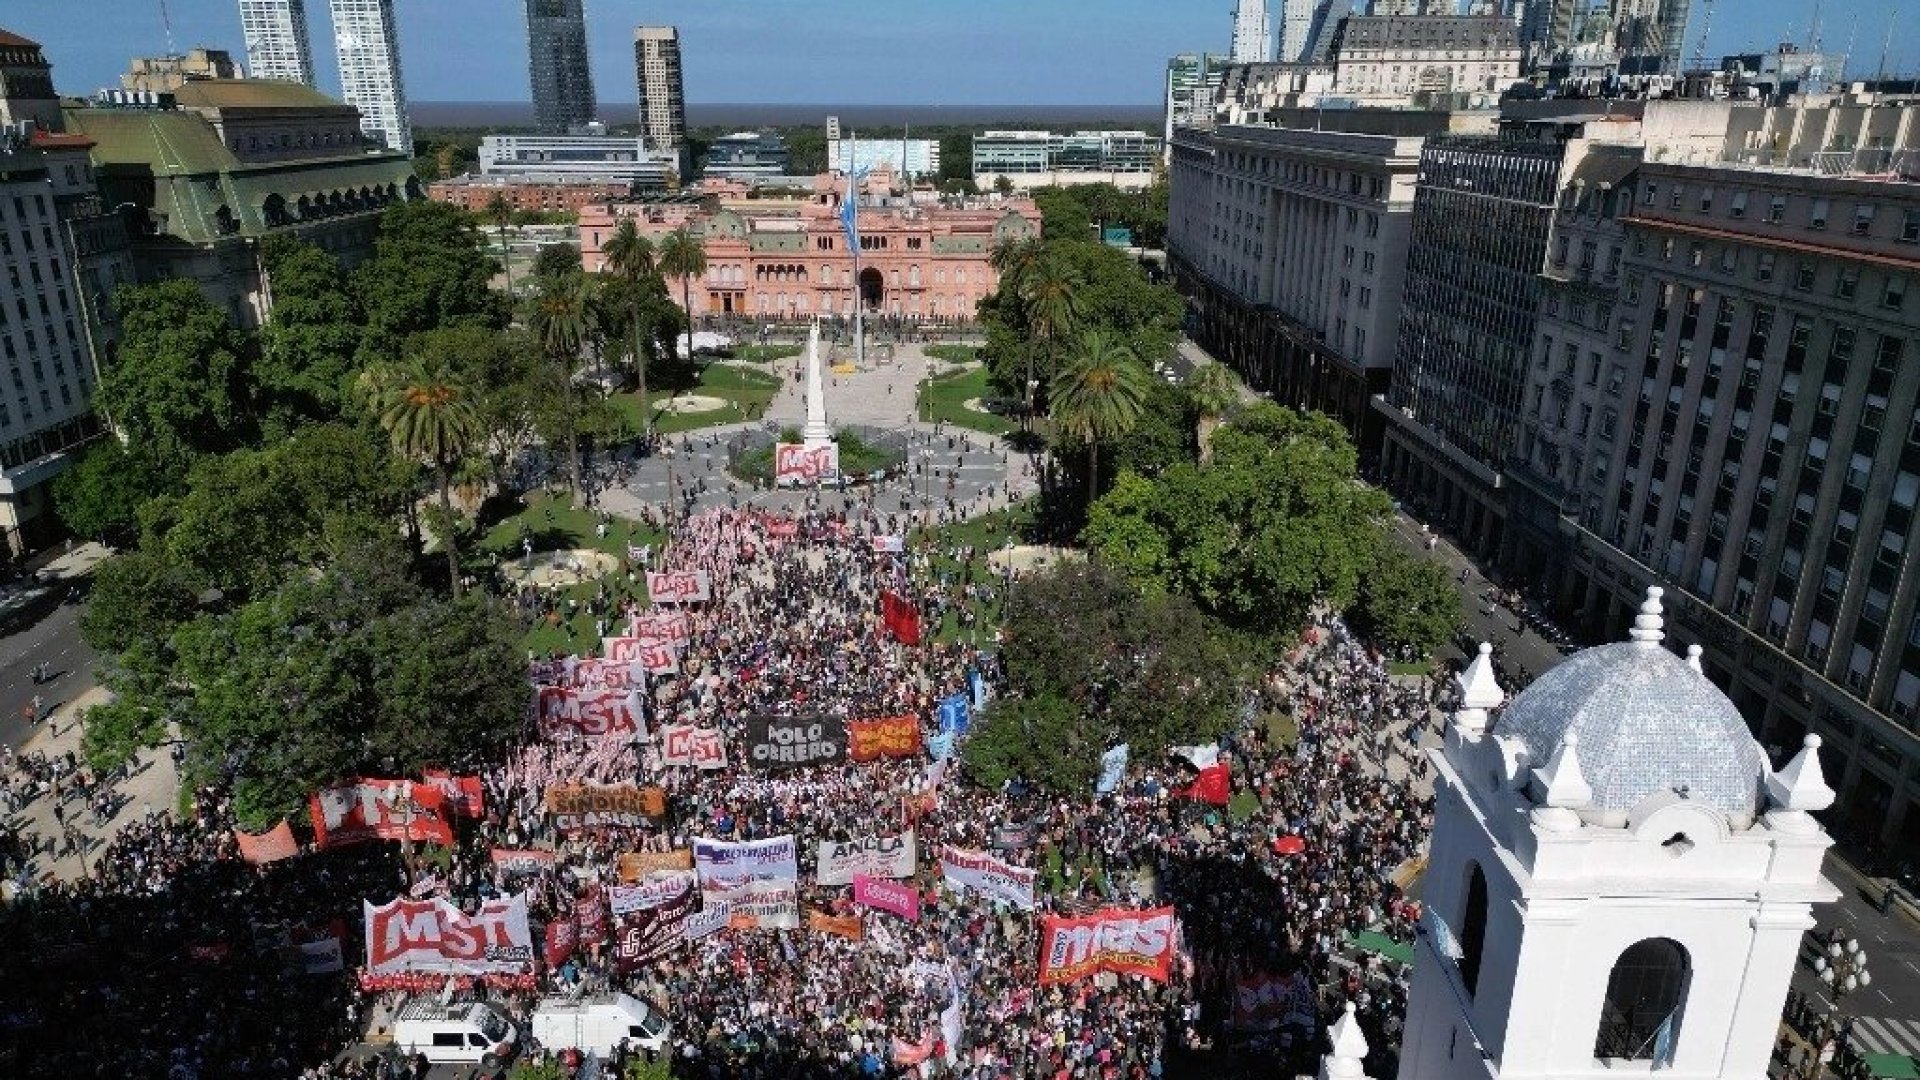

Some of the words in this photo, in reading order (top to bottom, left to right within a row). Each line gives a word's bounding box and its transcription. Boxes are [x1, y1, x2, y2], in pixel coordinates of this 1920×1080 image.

[777, 445, 832, 478] MST
[654, 573, 701, 597] MST
[637, 618, 685, 641] MST
[611, 639, 672, 668] MST
[539, 687, 638, 736] MST
[667, 728, 723, 762] MST
[768, 723, 822, 745] POLO
[753, 740, 838, 762] OBRERO
[831, 837, 905, 859] ANCLA
[372, 901, 516, 969] MST
